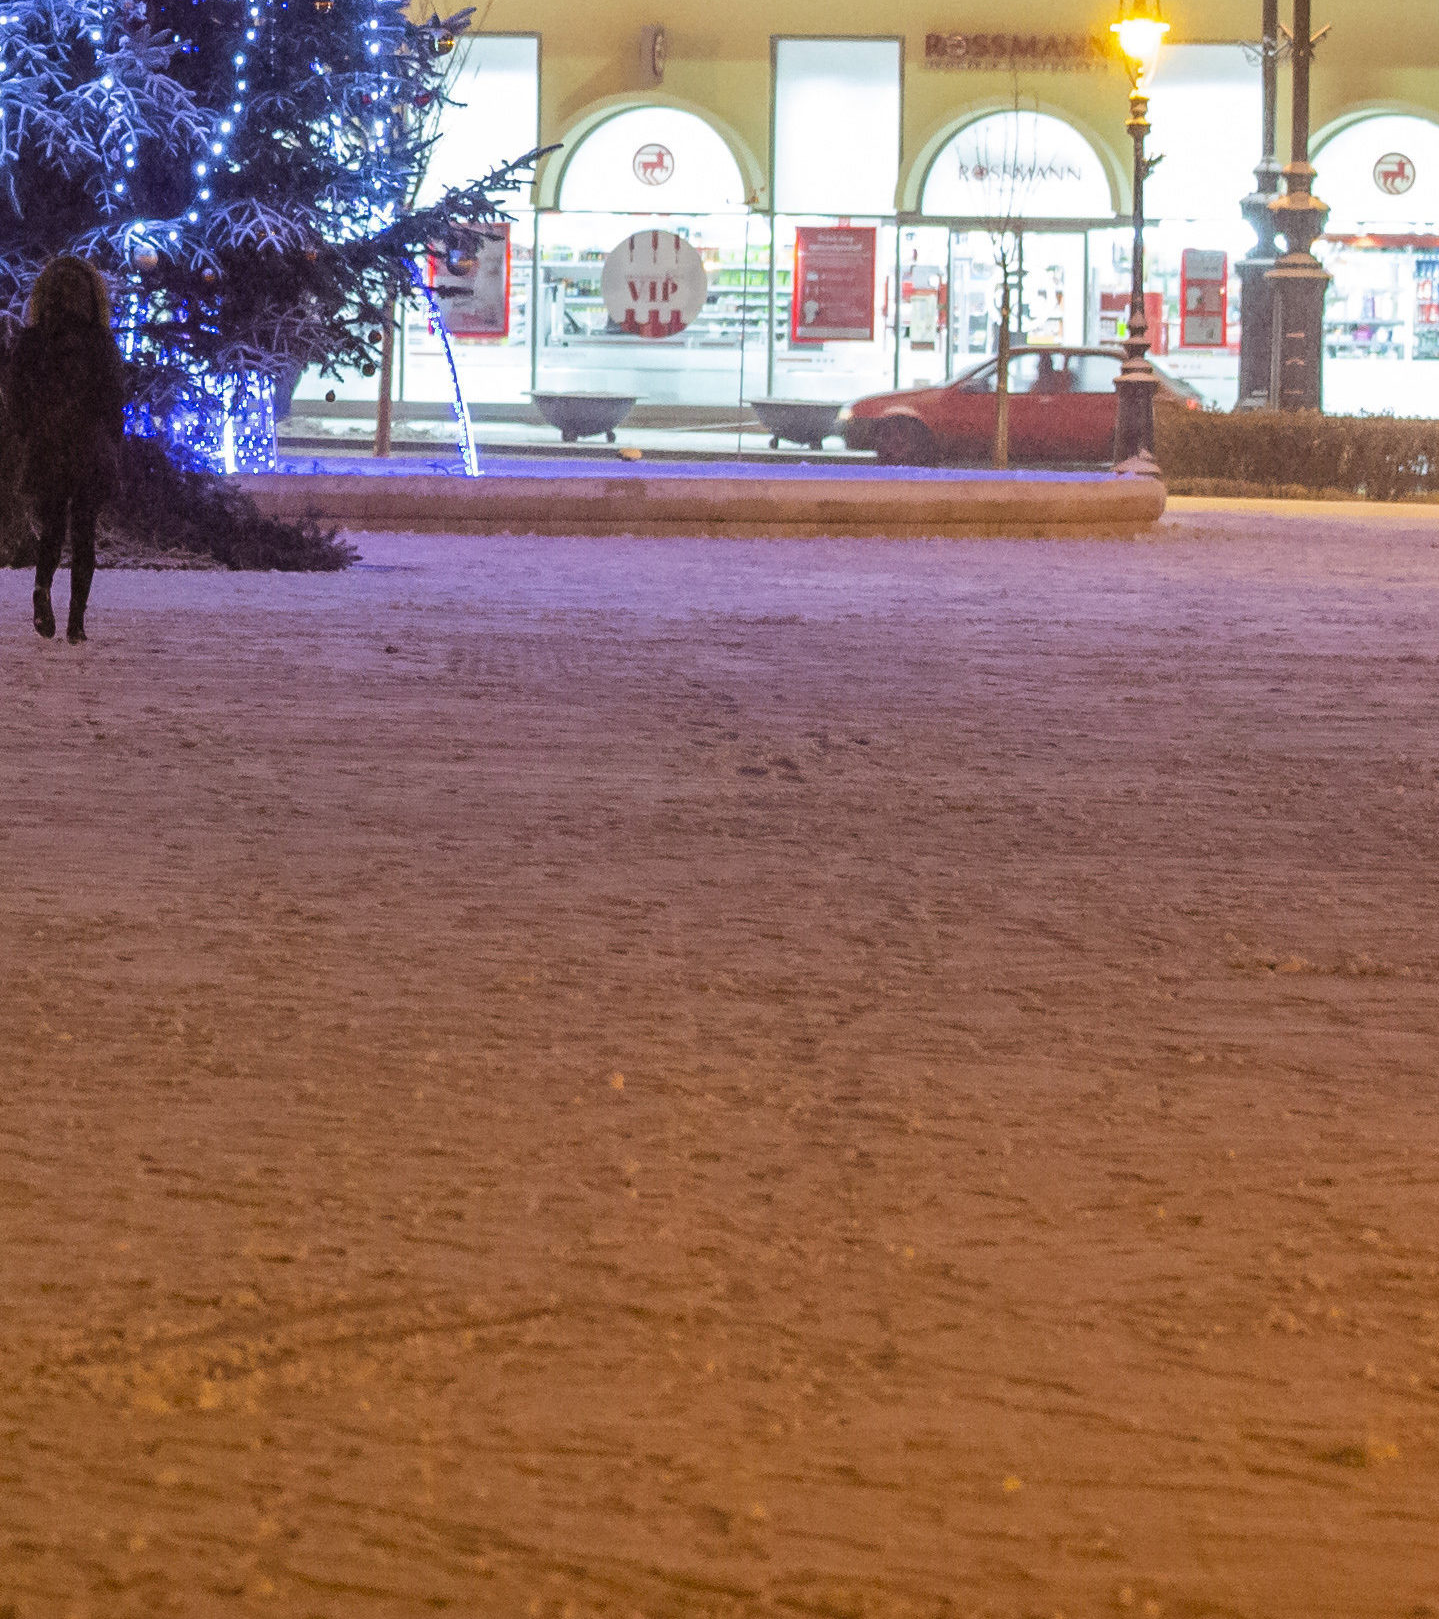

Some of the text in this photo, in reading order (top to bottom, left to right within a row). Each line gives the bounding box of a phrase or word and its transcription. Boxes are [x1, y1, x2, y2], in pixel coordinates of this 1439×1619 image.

[924, 33, 1113, 59] ROSSMANN
[958, 163, 1081, 182] ROSSMANN
[627, 280, 678, 302] VIP
